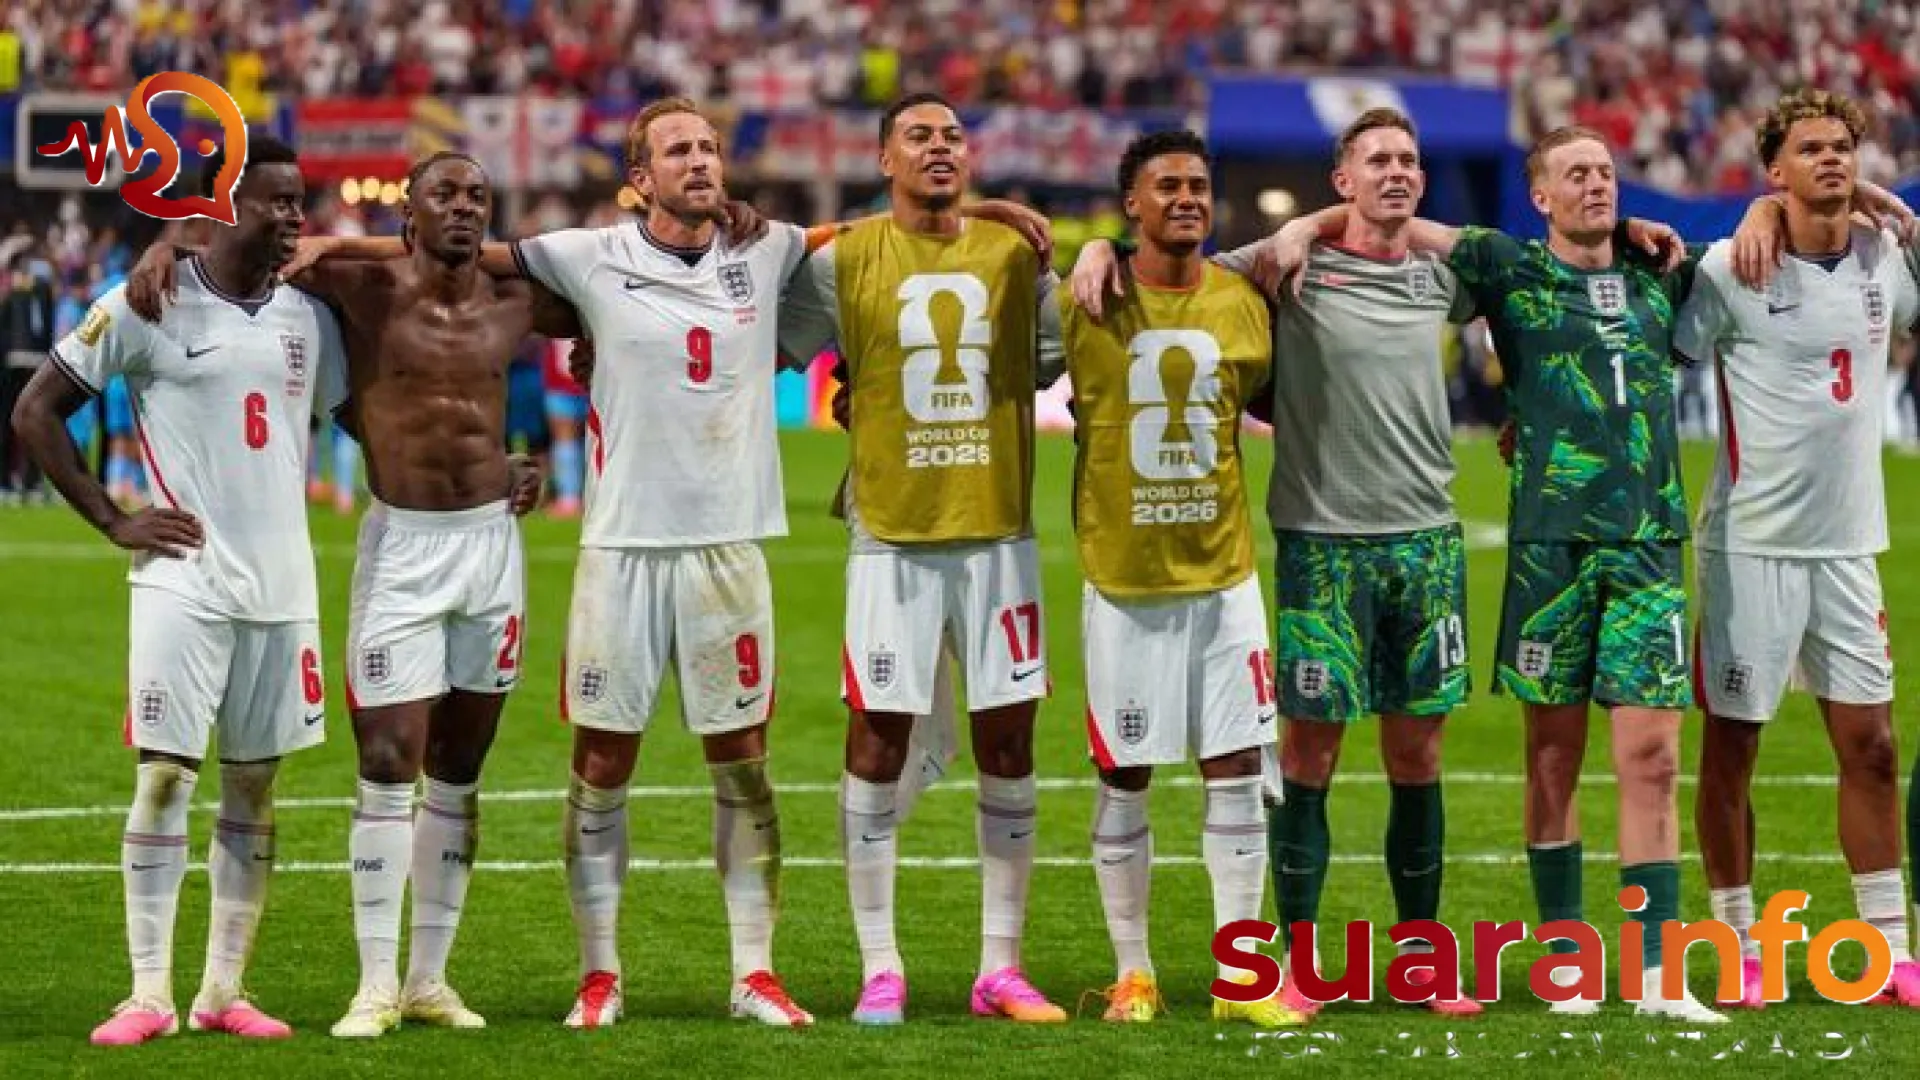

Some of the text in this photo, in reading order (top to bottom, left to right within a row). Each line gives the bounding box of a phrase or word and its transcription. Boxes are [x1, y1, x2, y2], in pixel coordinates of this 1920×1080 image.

[686, 326, 713, 384] 9
[1608, 352, 1628, 407] 1
[1829, 347, 1854, 404] 3
[243, 391, 270, 451] 6
[930, 392, 973, 408] FIFA
[905, 427, 965, 445] WORLD
[1158, 449, 1196, 466] FIFA
[1131, 486, 1190, 502] WORLD
[1131, 500, 1219, 526] 2026
[496, 614, 523, 671] 2
[735, 632, 761, 688] 9
[1000, 601, 1039, 664] 17
[1433, 614, 1466, 669] 13
[1671, 614, 1684, 667] 1
[301, 648, 325, 705] 6
